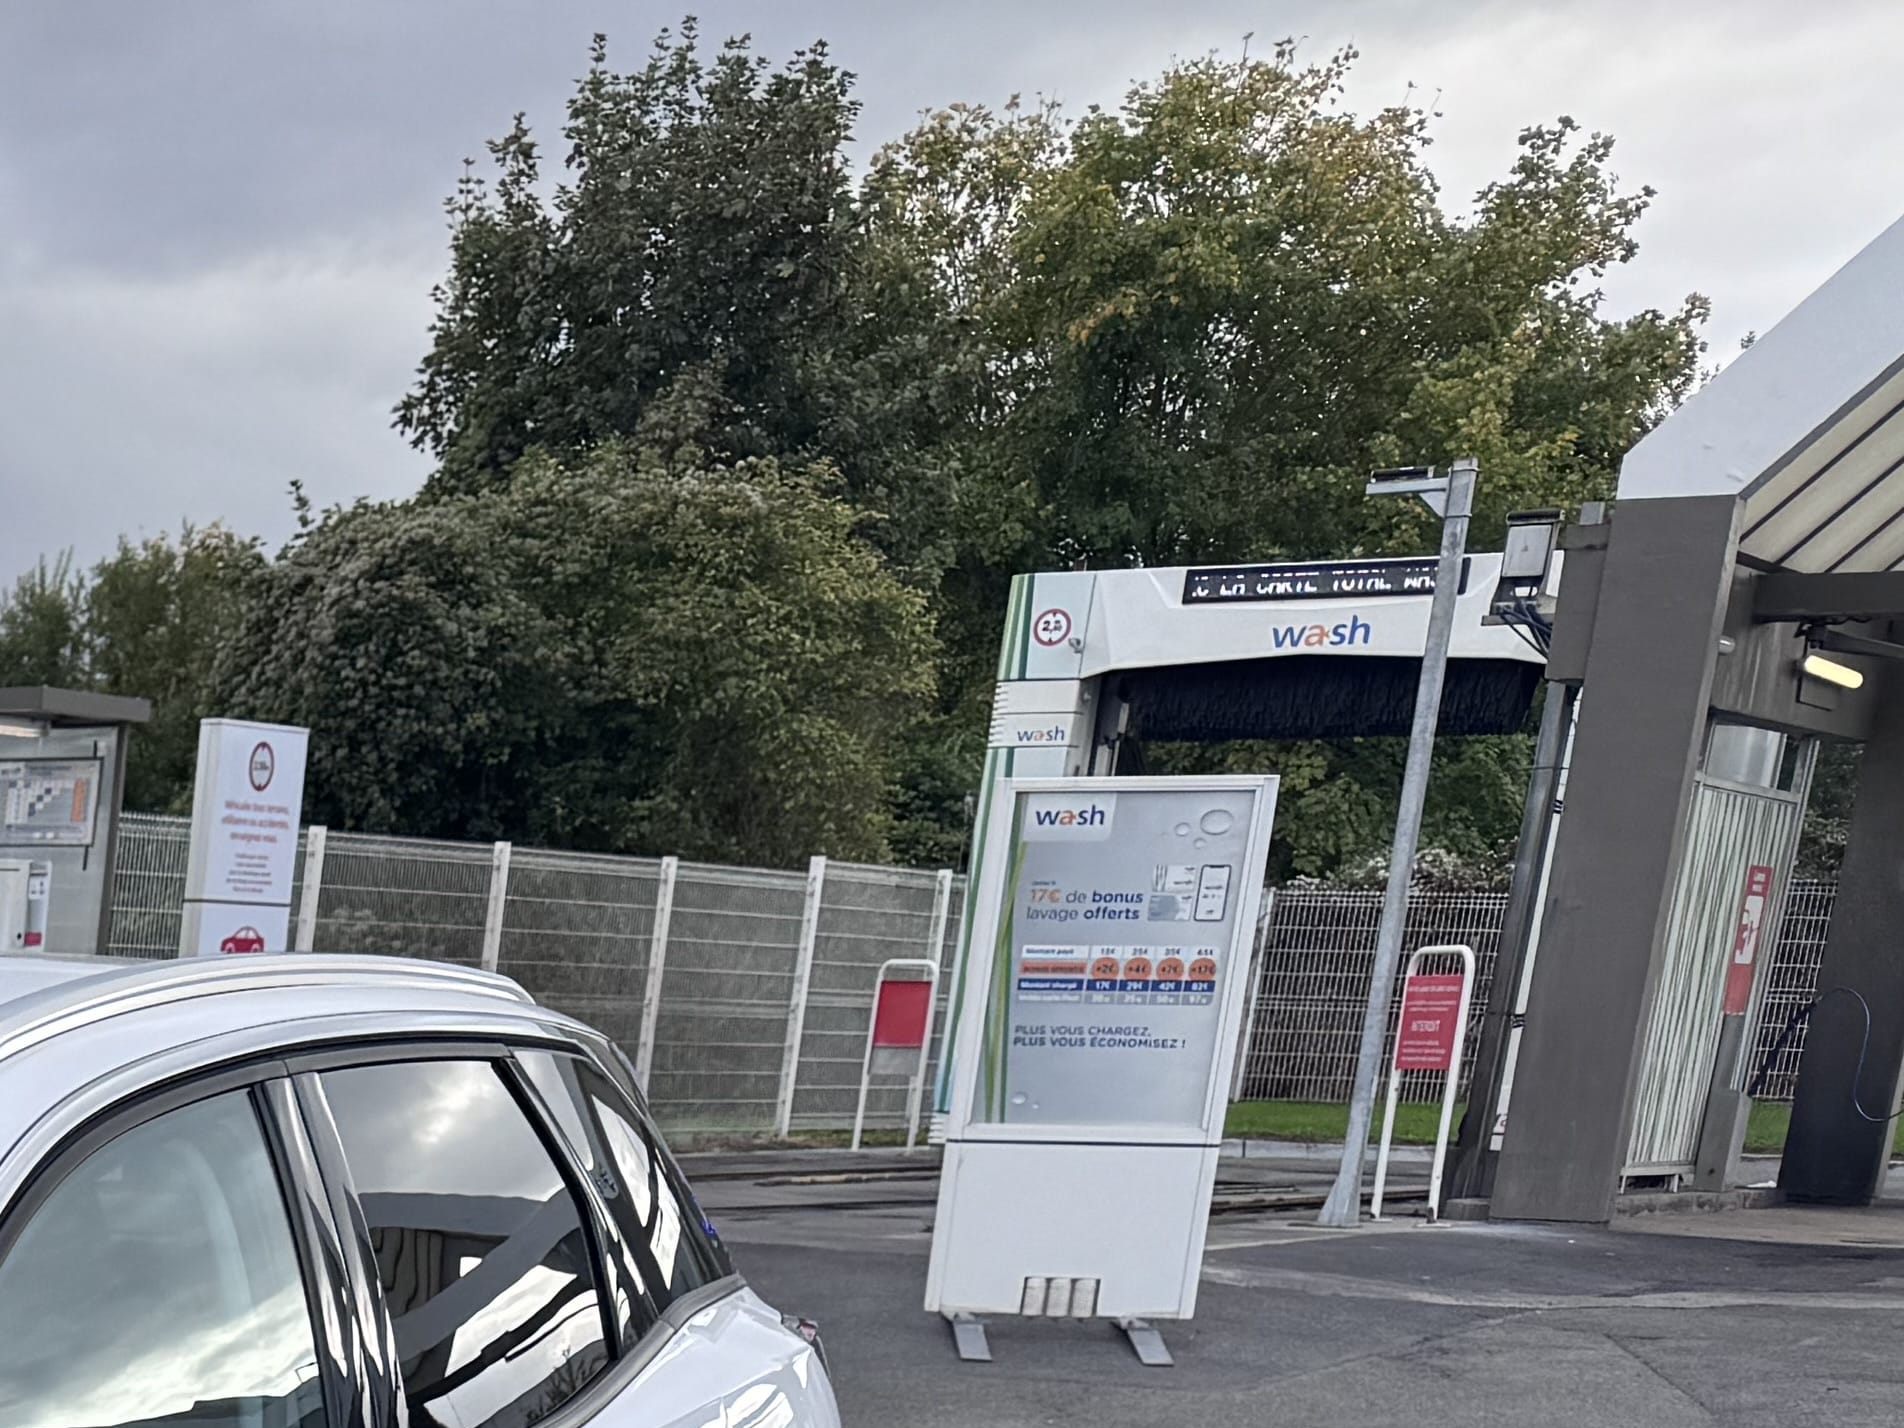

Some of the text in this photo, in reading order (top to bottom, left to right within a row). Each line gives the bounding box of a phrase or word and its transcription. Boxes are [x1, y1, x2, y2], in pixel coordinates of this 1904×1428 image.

[1272, 614, 1371, 648] wash
[1017, 725, 1065, 742] wash
[1036, 804, 1105, 826] wash
[1065, 889, 1087, 904] de
[1092, 889, 1144, 904] bonus
[1026, 905, 1140, 922] lavage offerts
[1015, 1025, 1046, 1036] PLUS
[1050, 1026, 1084, 1036] VOUS
[1013, 1036, 1046, 1046] PLUS
[1050, 1036, 1086, 1047] VOUS
[1091, 1035, 1178, 1049] ÉCONOMISEZ
